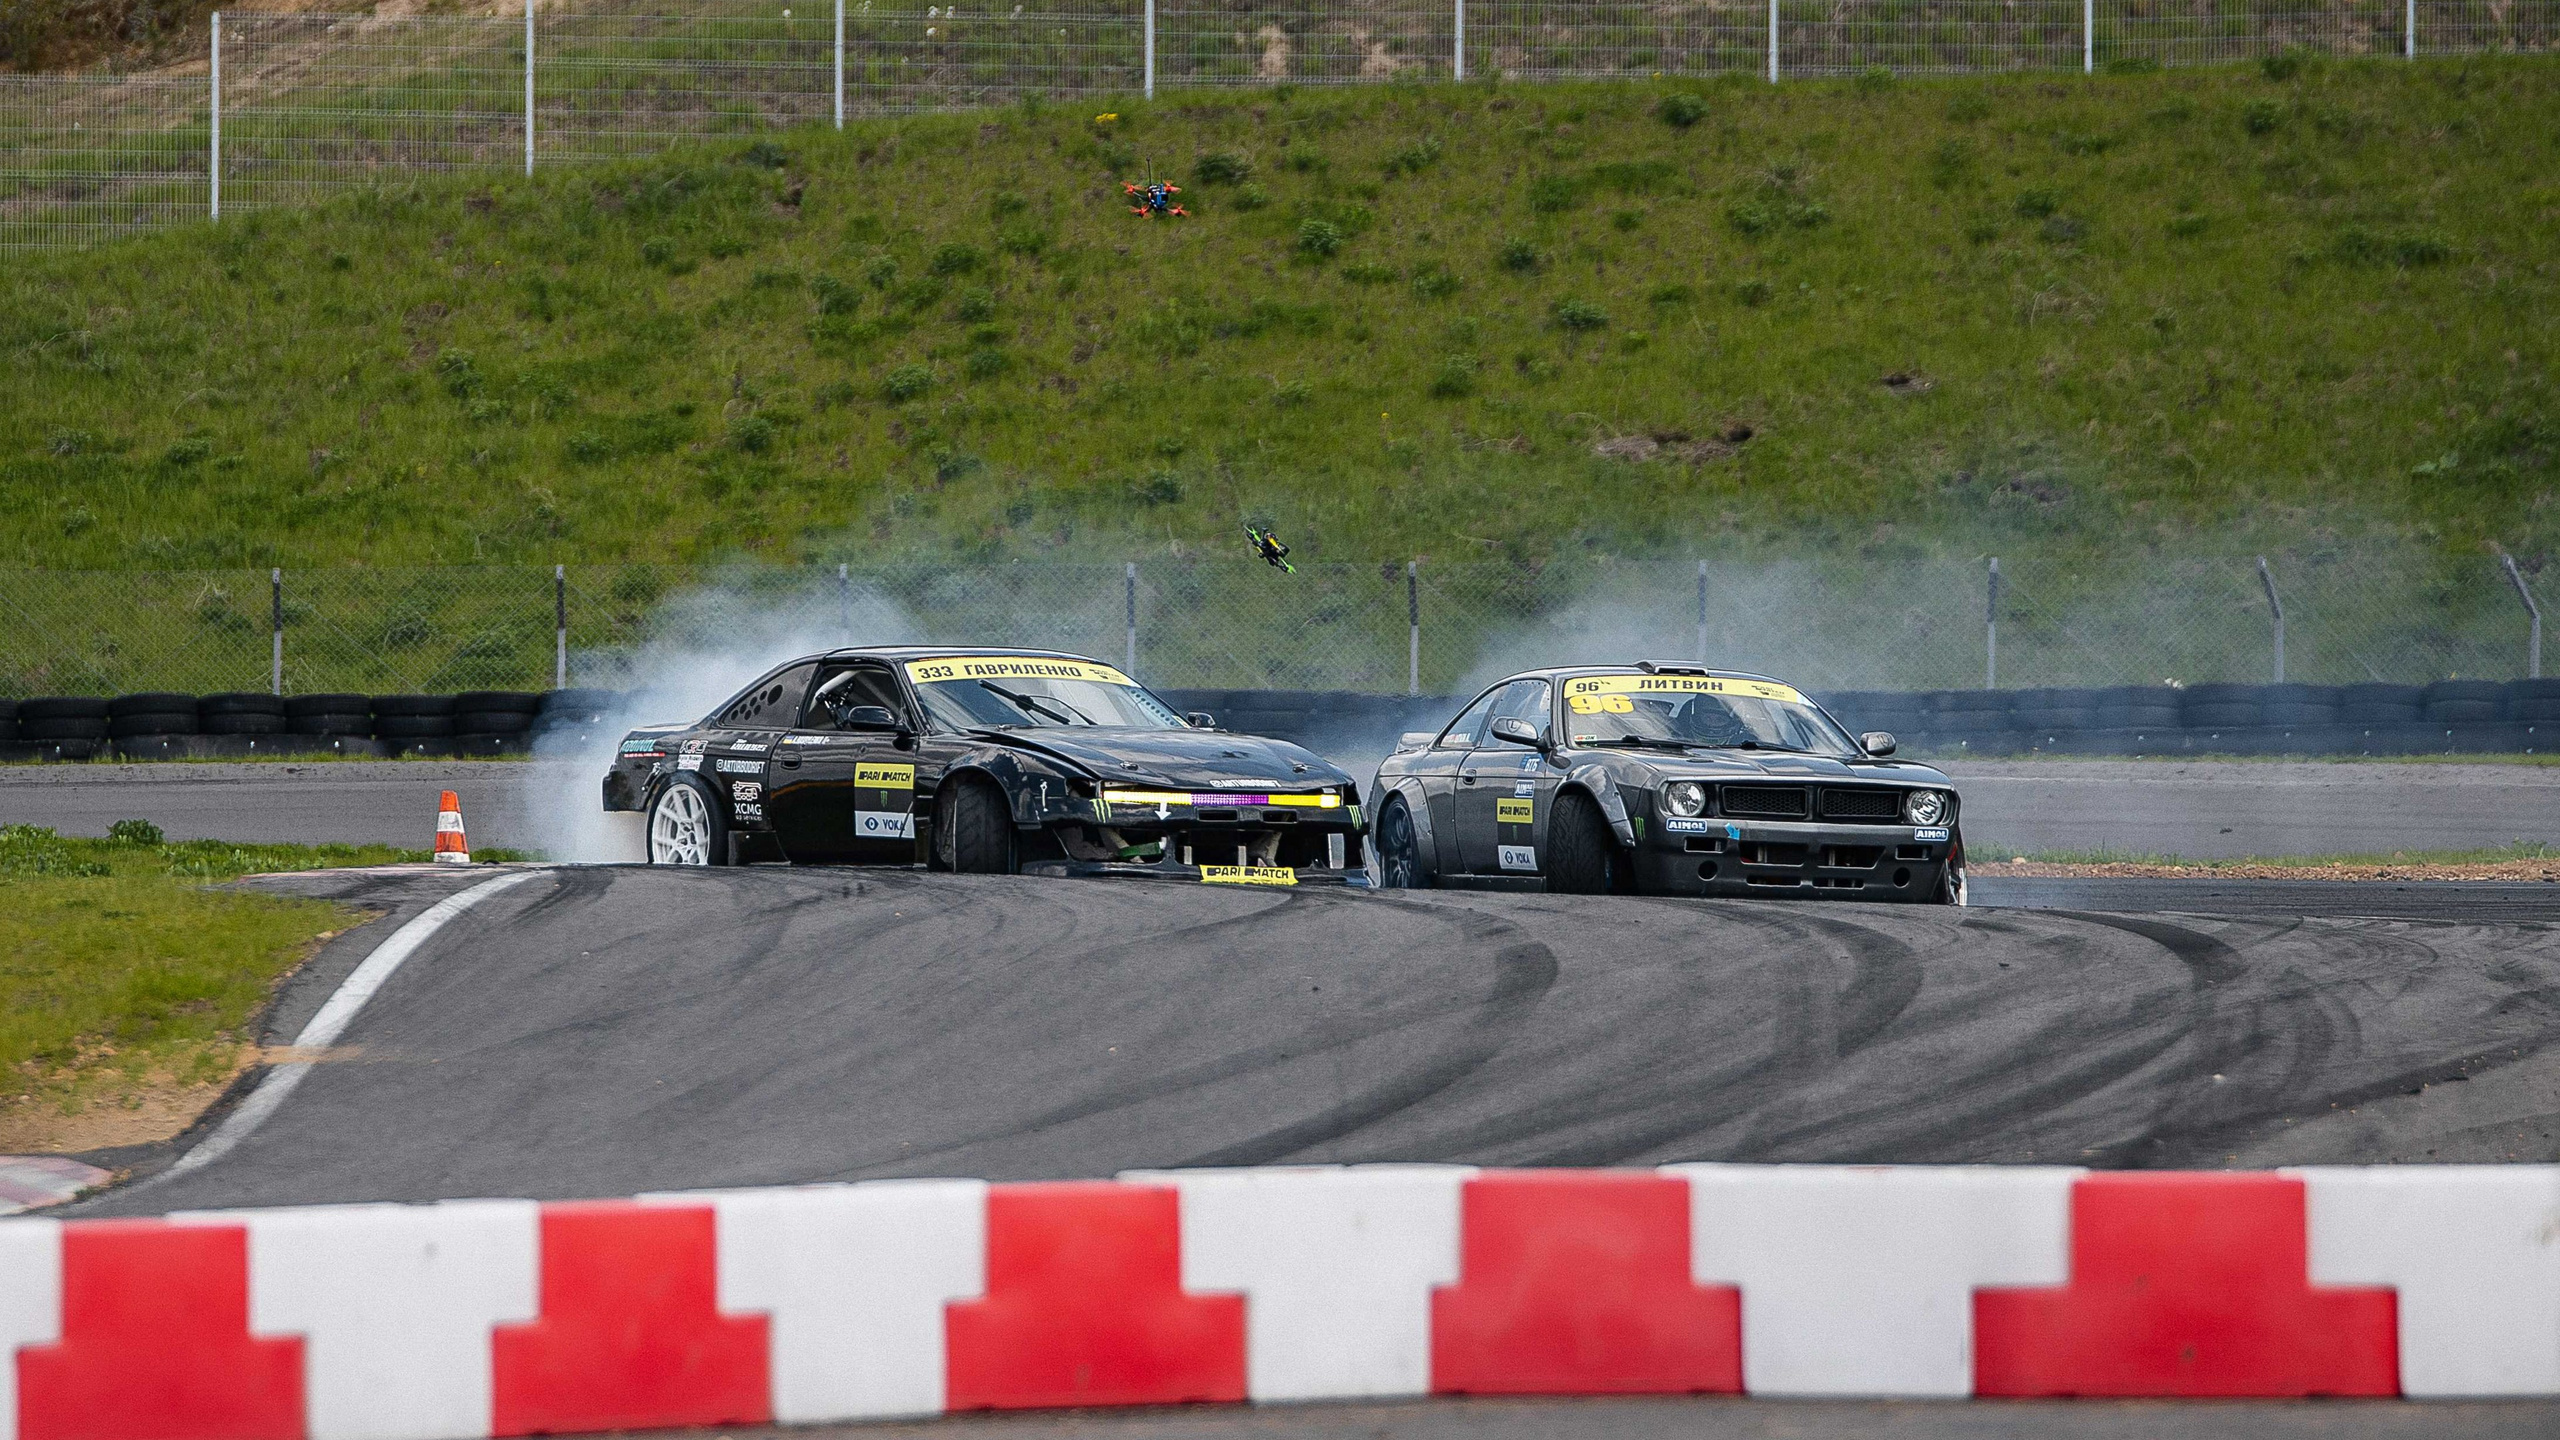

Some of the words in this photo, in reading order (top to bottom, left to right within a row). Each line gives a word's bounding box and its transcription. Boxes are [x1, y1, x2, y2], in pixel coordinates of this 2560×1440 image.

[918, 665, 953, 679] 333
[964, 664, 1082, 677] ГАВРИЛЕНКО
[1575, 681, 1600, 692] 96
[1638, 680, 1723, 691] ЛИТВИН
[1569, 694, 1634, 714] 96
[859, 771, 880, 780] PARI
[881, 772, 911, 781] MATCH
[734, 803, 762, 815] XCMG
[1668, 820, 1705, 831] AIMOL
[1916, 828, 1947, 839] AIMOL
[1207, 867, 1240, 877] PARI
[1245, 868, 1289, 879] MATCH
